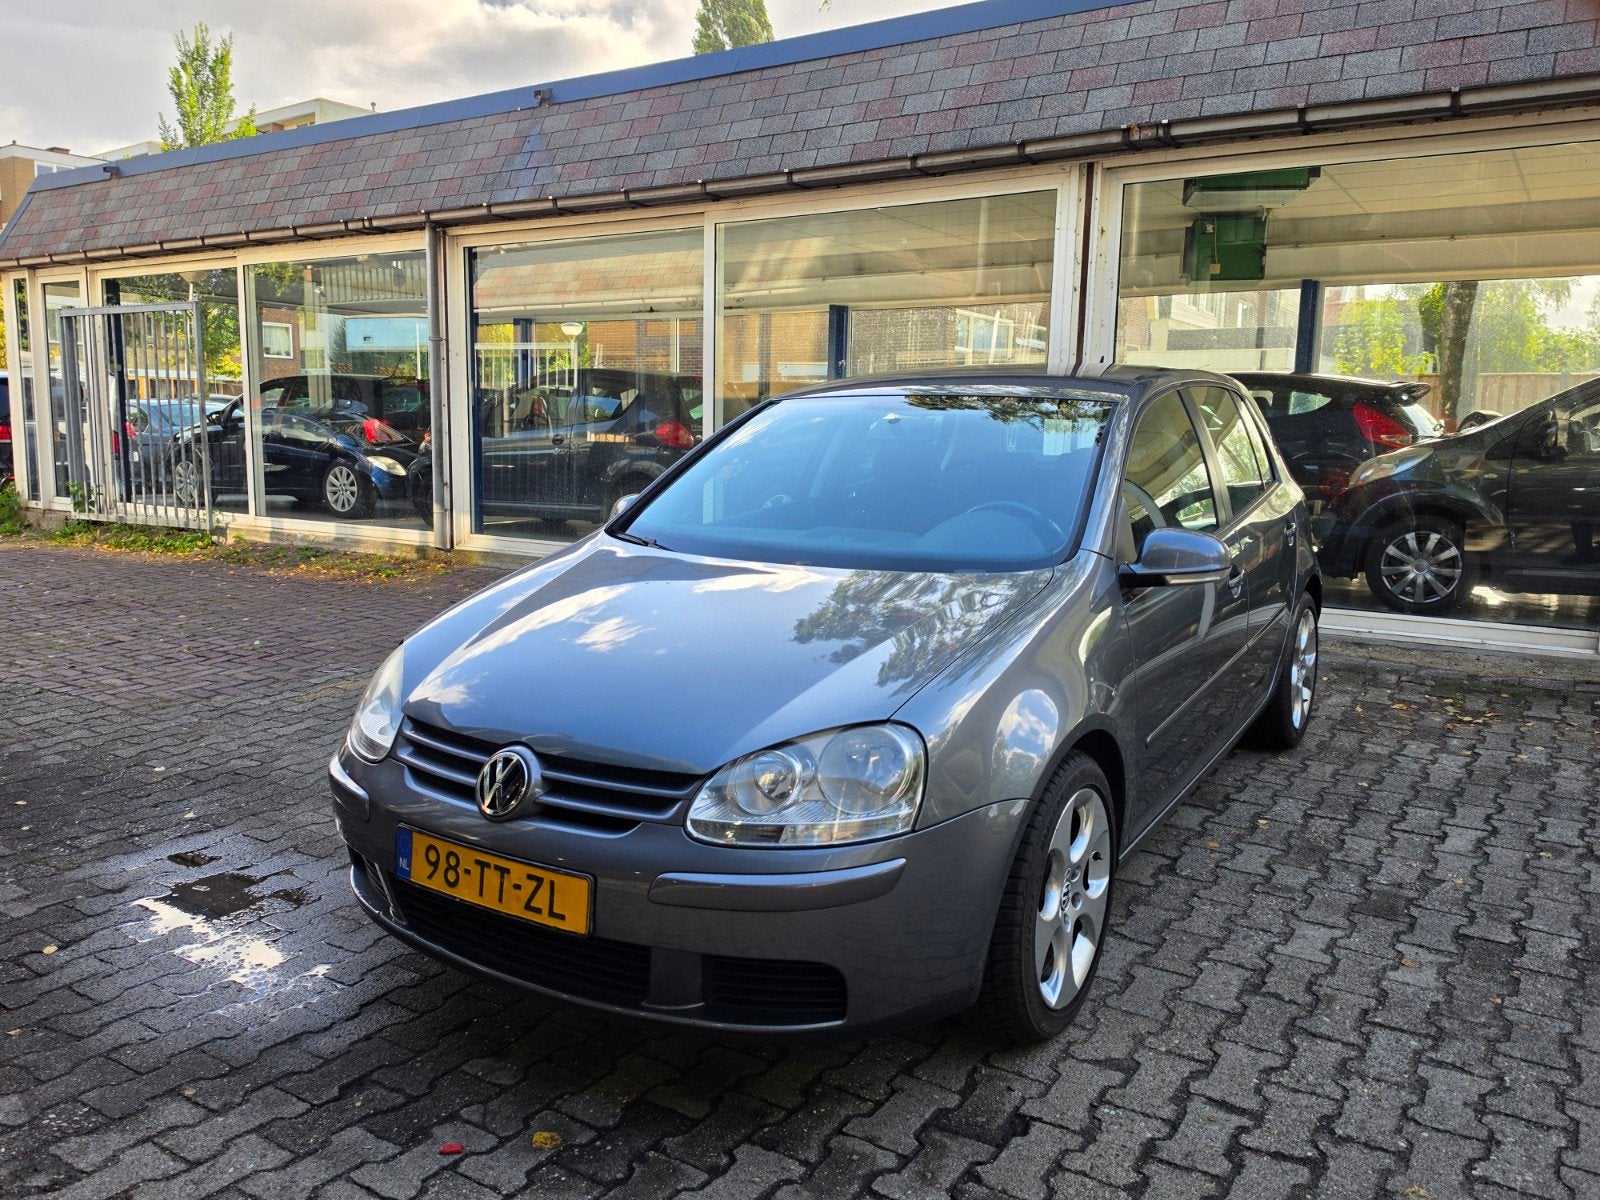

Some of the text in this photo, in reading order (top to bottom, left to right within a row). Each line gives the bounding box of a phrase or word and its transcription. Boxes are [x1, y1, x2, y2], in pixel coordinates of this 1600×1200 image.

[479, 751, 527, 815] VW
[399, 856, 410, 870] NL
[425, 844, 566, 921] 98-TT-ZL
